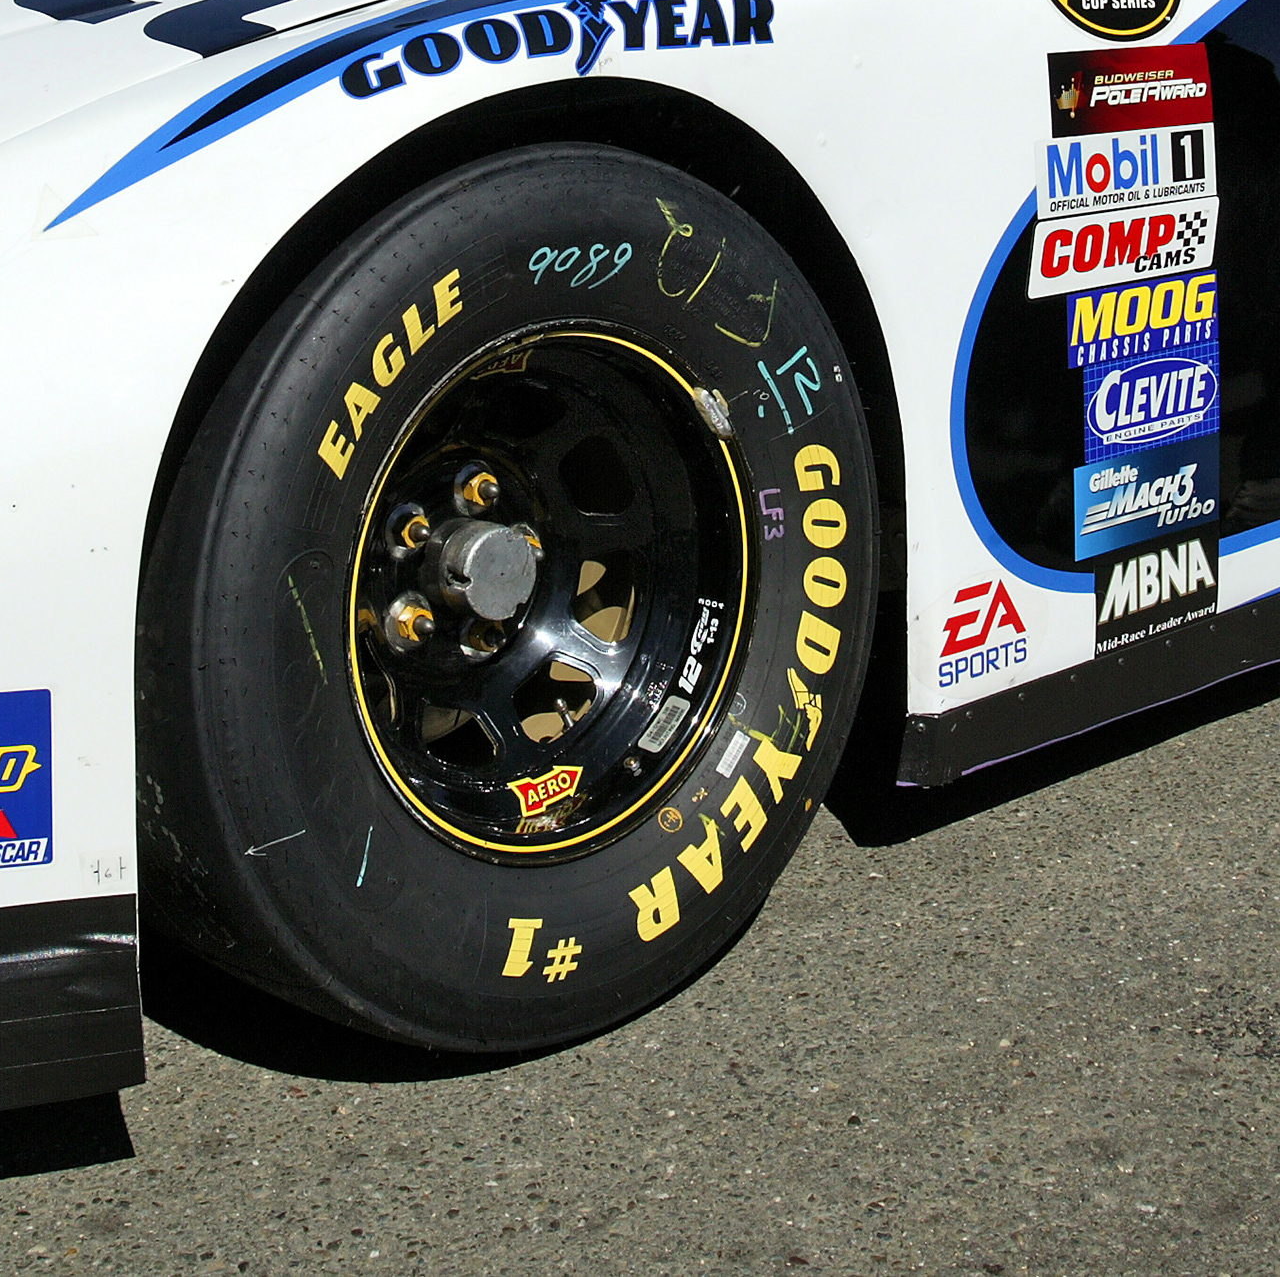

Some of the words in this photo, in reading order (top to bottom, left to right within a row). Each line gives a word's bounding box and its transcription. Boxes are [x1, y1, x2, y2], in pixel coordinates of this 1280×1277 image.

[1094, 69, 1174, 85] BUDWEISER
[1046, 133, 1160, 199] Mobil
[1050, 195, 1089, 212] OFFICIAL
[1092, 192, 1124, 207] MOTOR
[1128, 189, 1141, 202] OIL
[1144, 189, 1150, 199] &
[1153, 183, 1205, 199] LUBRICANTS
[1041, 214, 1176, 278] COMP
[1134, 247, 1196, 273] CAMS
[1070, 274, 1217, 346] MOOG
[1077, 332, 1151, 366] CHASSIS
[1162, 321, 1213, 349] PARTS
[317, 268, 464, 480] EAGLE
[1095, 364, 1209, 431] CLEVITE
[1106, 424, 1155, 443] ENGINE
[1160, 413, 1202, 428] PARTS
[1089, 464, 1139, 493] Gillette
[1156, 497, 1216, 528] Turbo
[698, 597, 724, 610] 2004
[1097, 537, 1216, 625] MBNA
[940, 579, 1027, 657] EA
[1096, 630, 1146, 655] Mid-Race
[1148, 615, 1182, 636] Leader
[1184, 602, 1216, 623] Award
[678, 655, 703, 694] 12
[939, 637, 1027, 688] SPORTS
[527, 772, 571, 805] AERO
